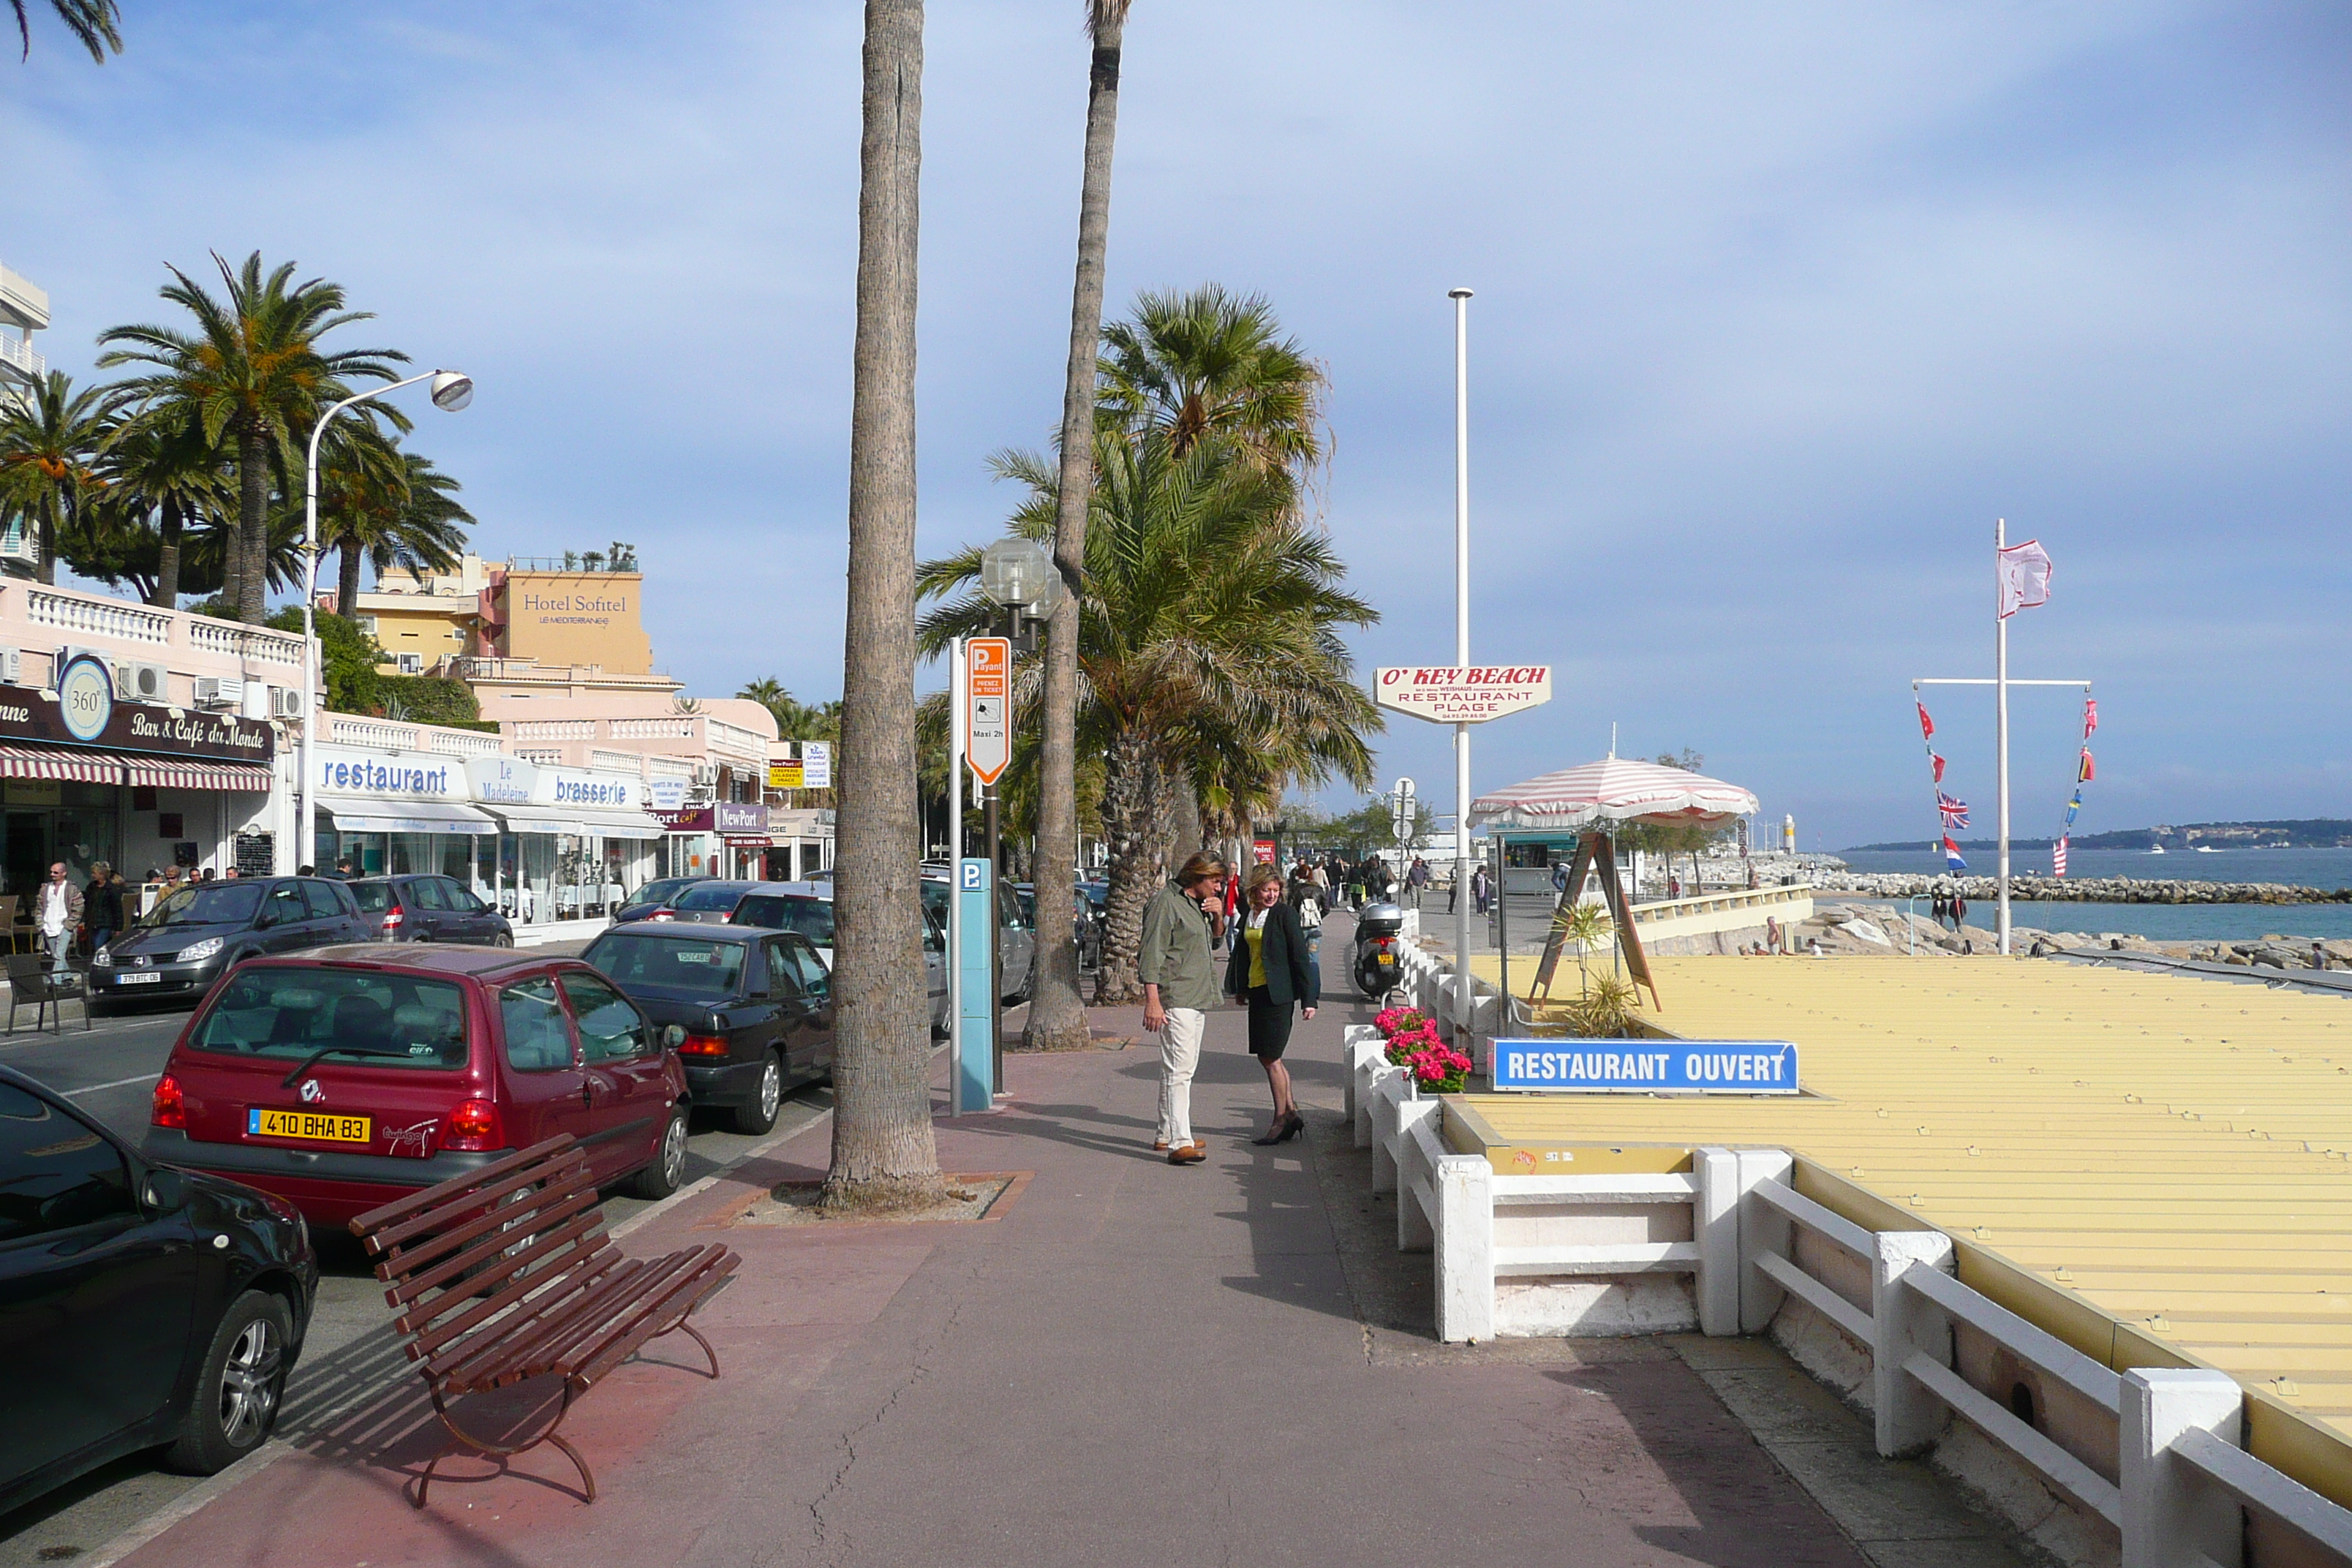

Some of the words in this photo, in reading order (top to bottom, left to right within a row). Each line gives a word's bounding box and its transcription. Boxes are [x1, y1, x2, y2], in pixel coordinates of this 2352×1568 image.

[524, 595, 570, 611] Hotel
[575, 595, 626, 612] Sofitel
[974, 649, 1002, 672] Payant
[1382, 668, 1409, 685] O'
[1413, 668, 1463, 685] KEY
[1466, 668, 1546, 685] BEACH
[1398, 692, 1533, 702] RESTAURANT
[1434, 704, 1499, 712] PLAGE
[132, 712, 159, 738] Bar
[162, 721, 172, 739] &
[175, 719, 204, 748] Café
[208, 723, 225, 745] du
[225, 725, 264, 749] Monde
[323, 758, 447, 793] restaurant
[500, 761, 512, 780] Le
[483, 783, 528, 803] Madeleine
[555, 775, 627, 804] brasserie
[722, 808, 757, 827] NewPort
[410, 1047, 425, 1055] elf
[1508, 1052, 1670, 1080] RESTAURANT
[1686, 1054, 1785, 1081] OUVERT
[266, 1113, 298, 1134] 410
[304, 1116, 336, 1137] BHA
[340, 1120, 363, 1139] 83
[382, 1126, 422, 1145] twingo
